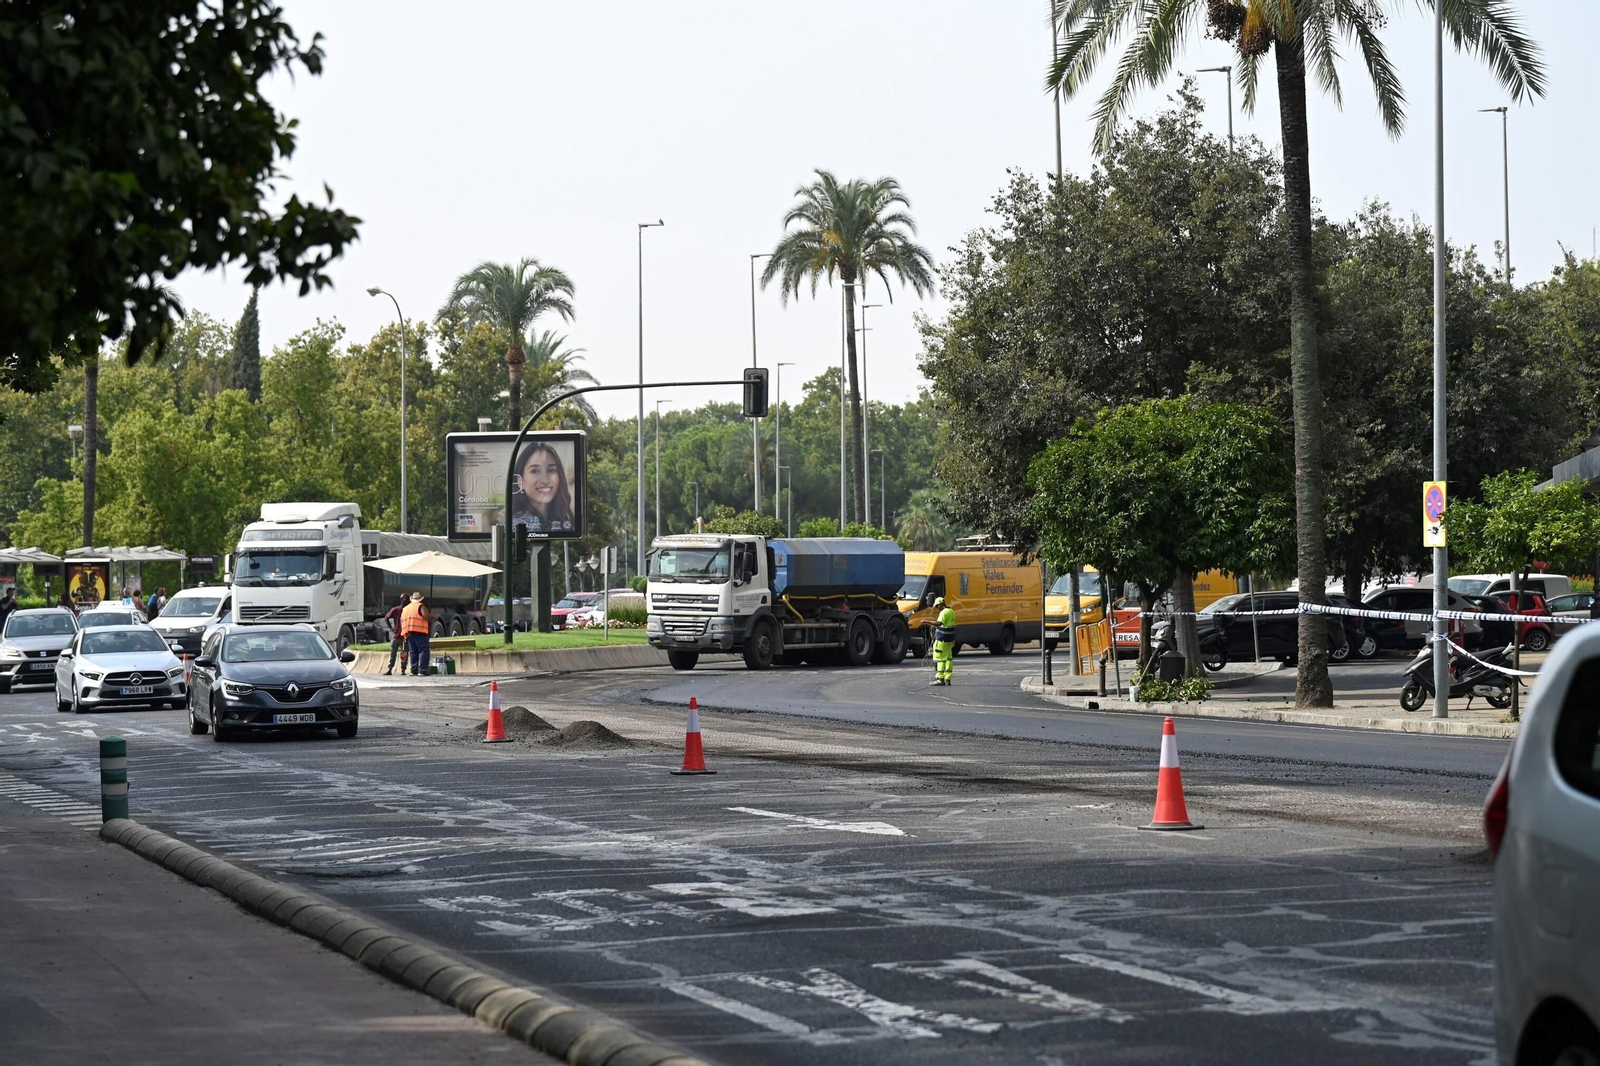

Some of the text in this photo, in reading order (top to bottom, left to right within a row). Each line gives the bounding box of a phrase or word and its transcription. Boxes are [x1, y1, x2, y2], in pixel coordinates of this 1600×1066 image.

[330, 531, 349, 541] Sergio
[983, 569, 1005, 581] Viales
[985, 582, 1024, 595] Fernández
[299, 714, 314, 722] MDB
